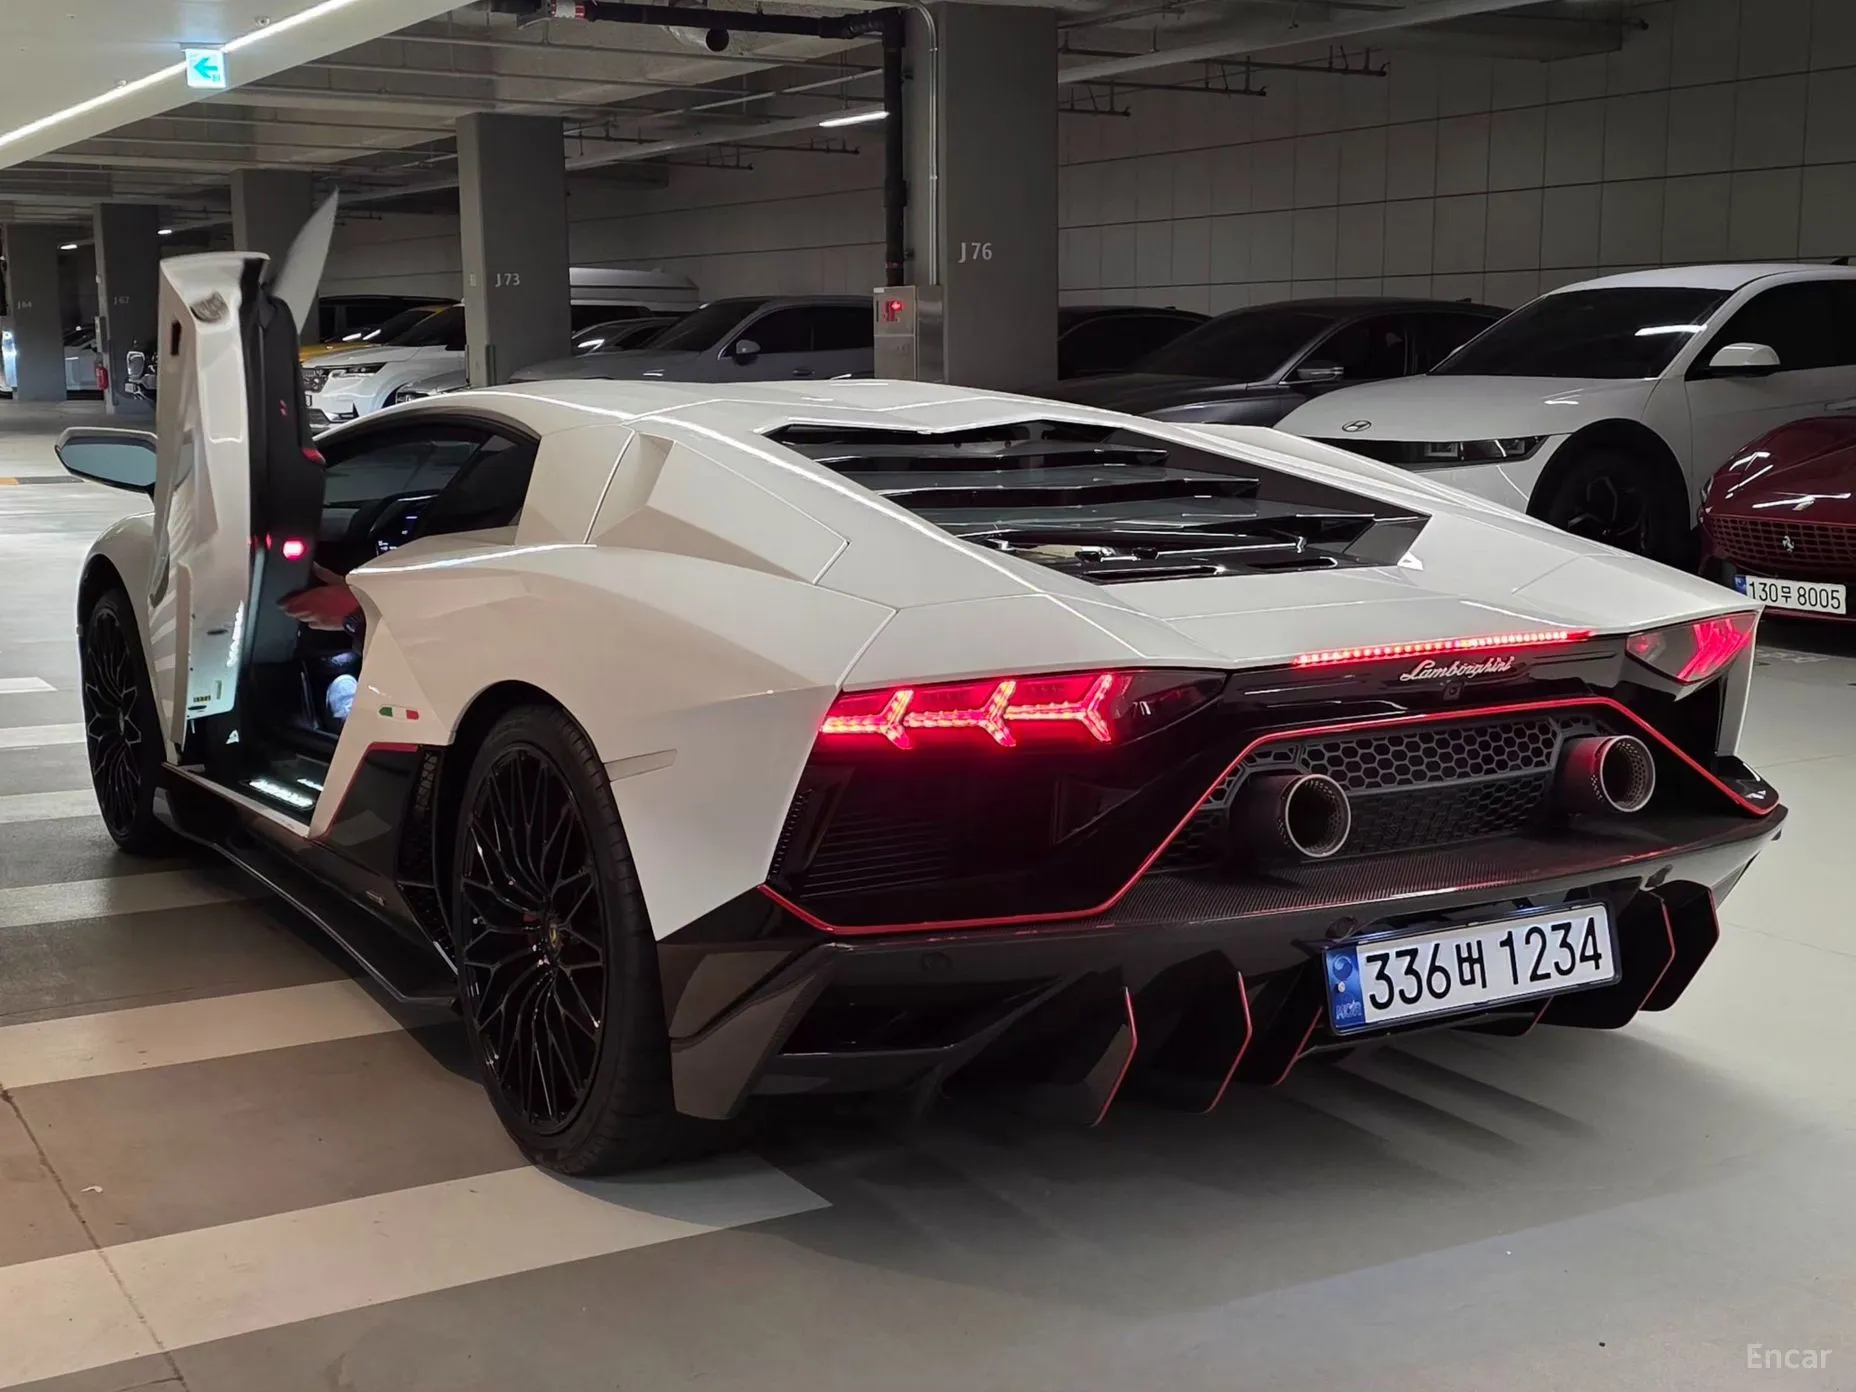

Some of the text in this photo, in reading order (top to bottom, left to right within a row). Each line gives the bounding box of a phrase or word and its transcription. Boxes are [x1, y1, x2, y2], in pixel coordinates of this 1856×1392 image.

[1749, 581, 1841, 610] 130무 8005
[1399, 656, 1515, 681] Lamborghini
[1365, 916, 1603, 1010] 336버 1234
